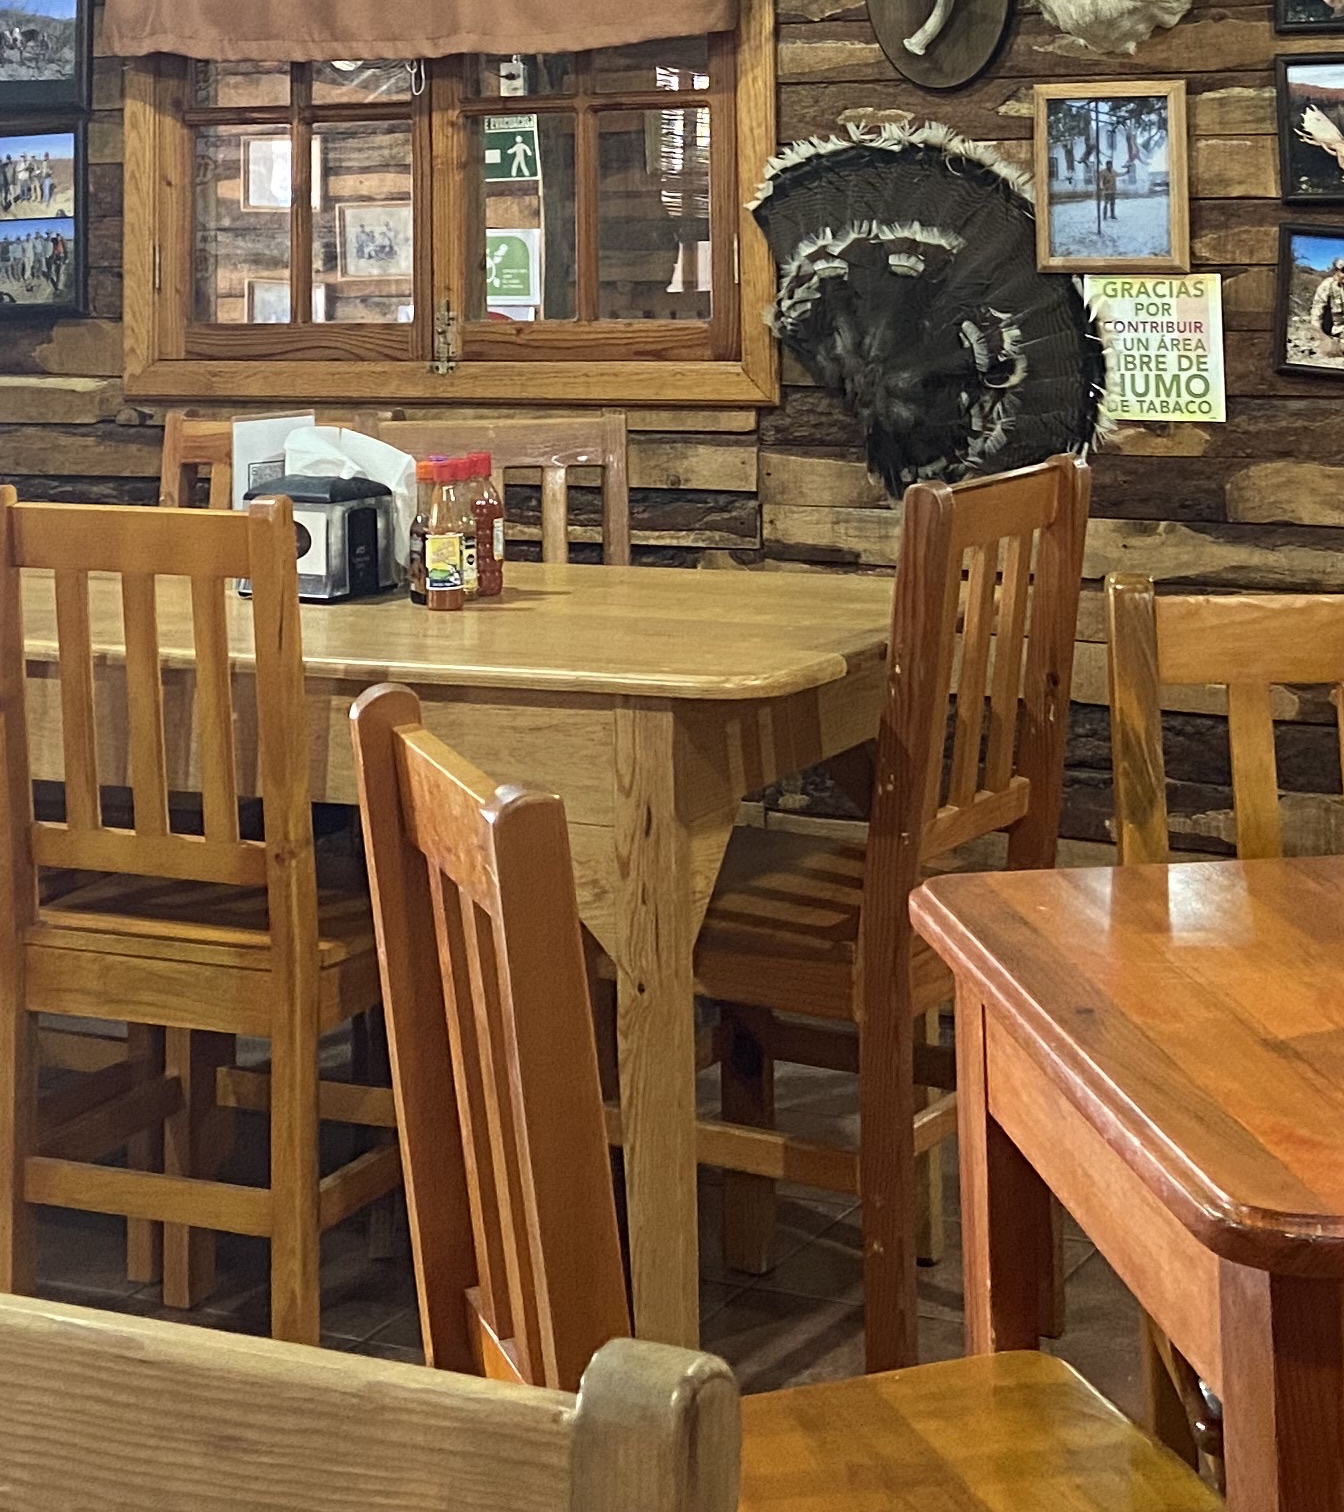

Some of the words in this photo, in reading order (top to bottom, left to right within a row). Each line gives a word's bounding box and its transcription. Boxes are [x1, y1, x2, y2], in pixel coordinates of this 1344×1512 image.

[1102, 280, 1205, 299] GRACIAS
[1135, 302, 1172, 317] POR
[1123, 337, 1149, 352] UN
[1157, 334, 1206, 352] ÁREA
[1117, 354, 1168, 372] IBRE
[1177, 354, 1209, 372] DE
[1137, 399, 1212, 415] TABACO
